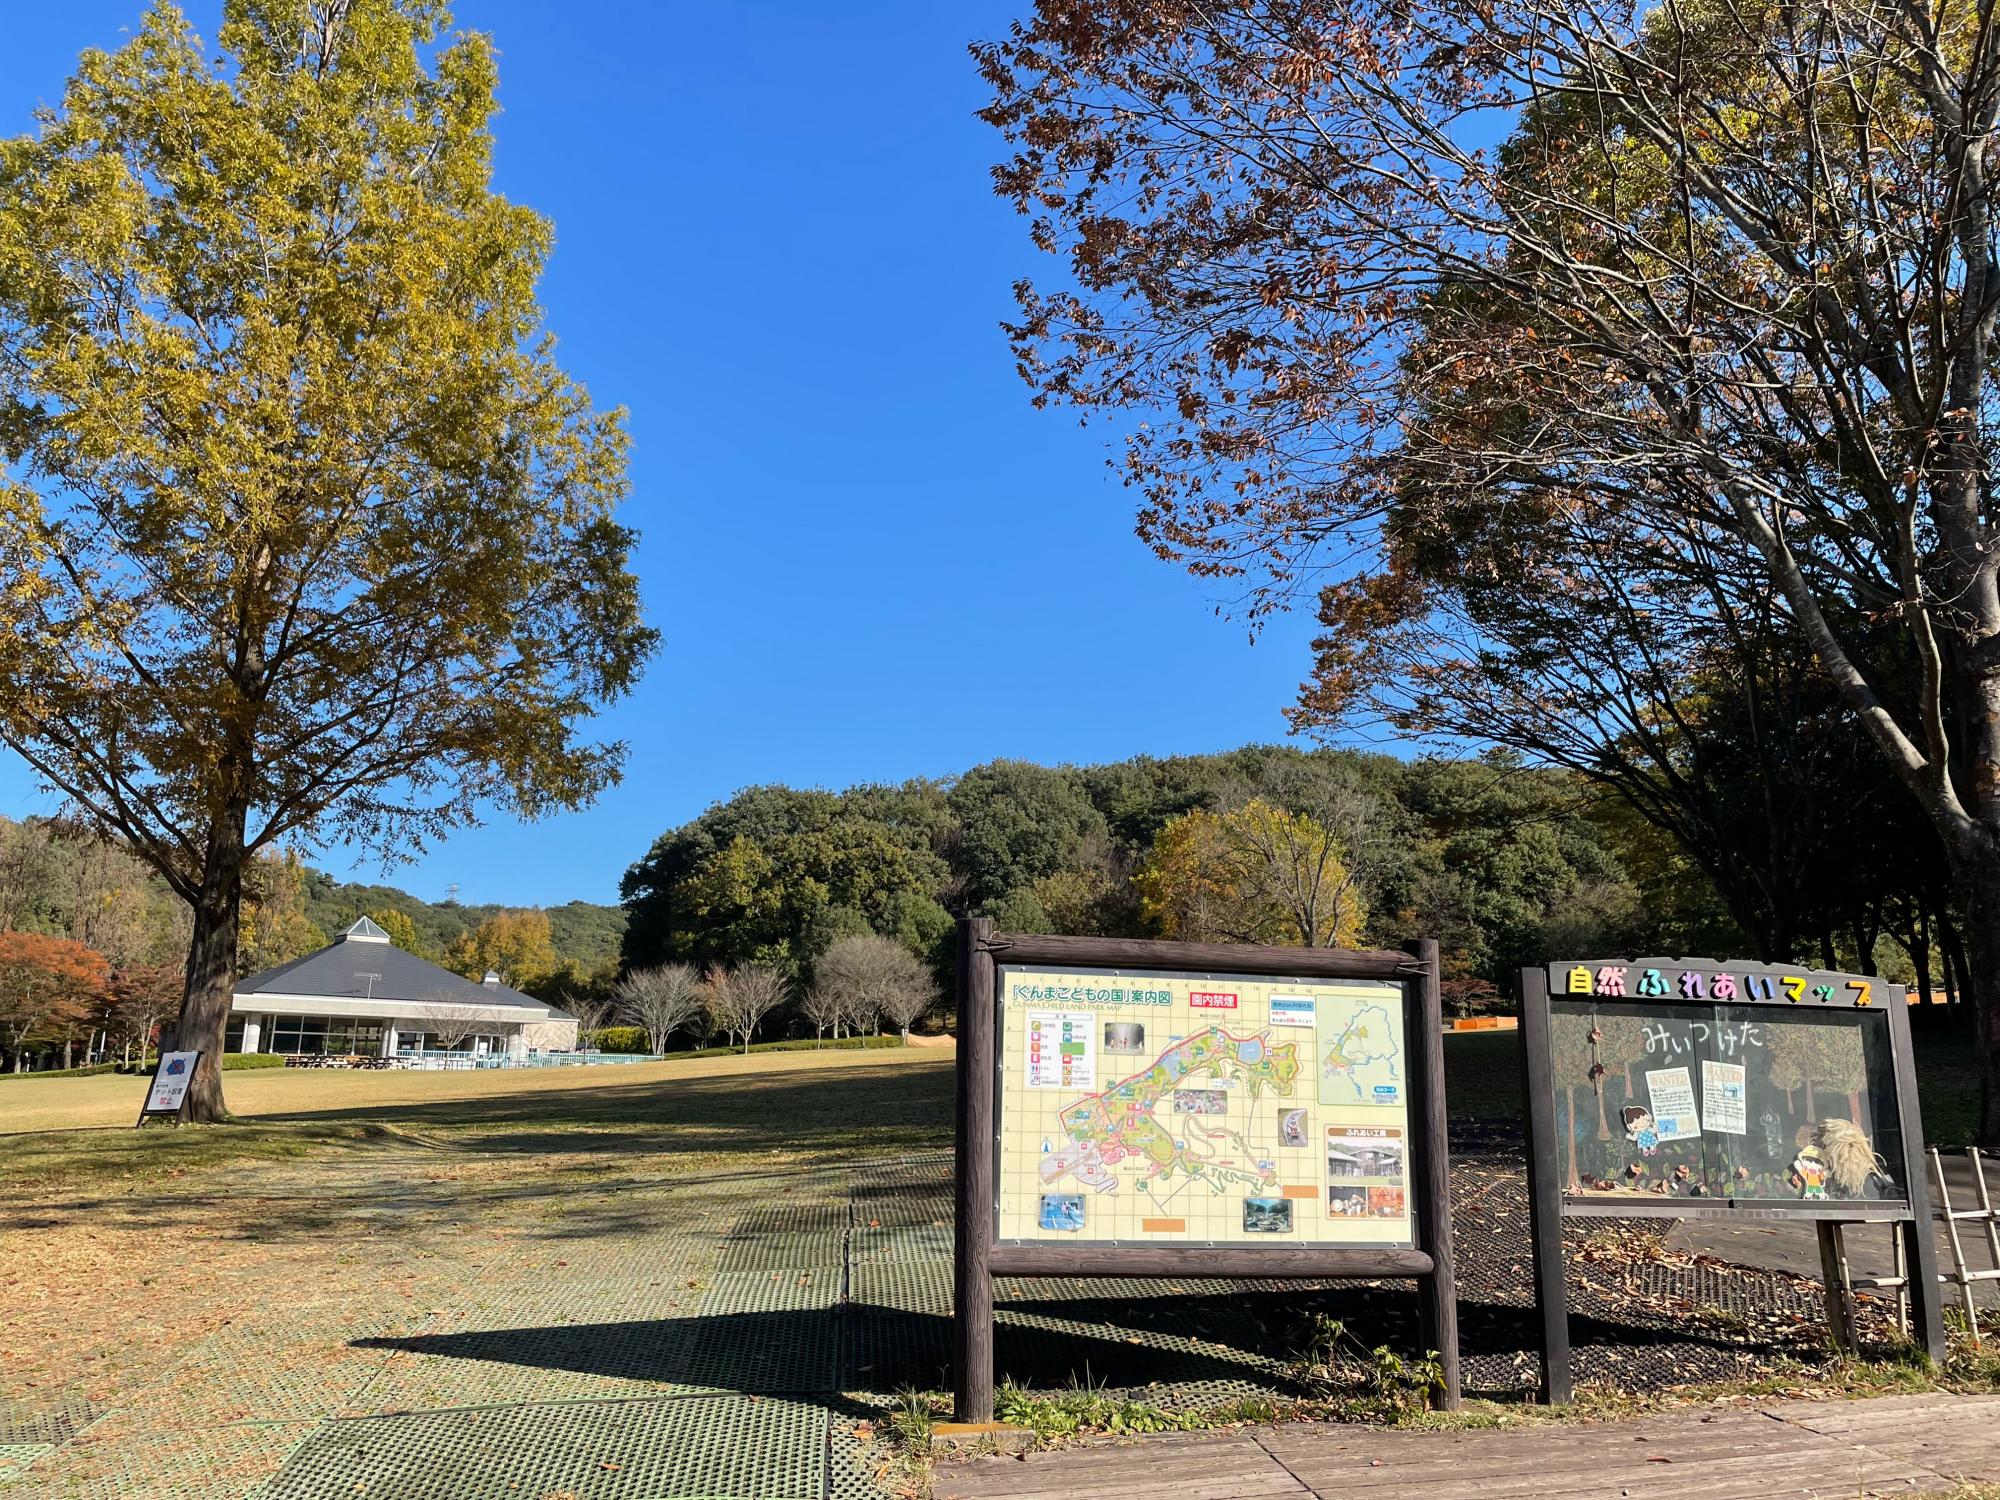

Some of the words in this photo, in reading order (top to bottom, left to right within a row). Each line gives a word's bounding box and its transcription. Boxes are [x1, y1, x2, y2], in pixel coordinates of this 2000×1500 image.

[1013, 985, 1171, 1004] 「ぐんまこどもの国」案内図
[1013, 1001, 1040, 1009] GUNMA
[1042, 1002, 1064, 1010] CHILD
